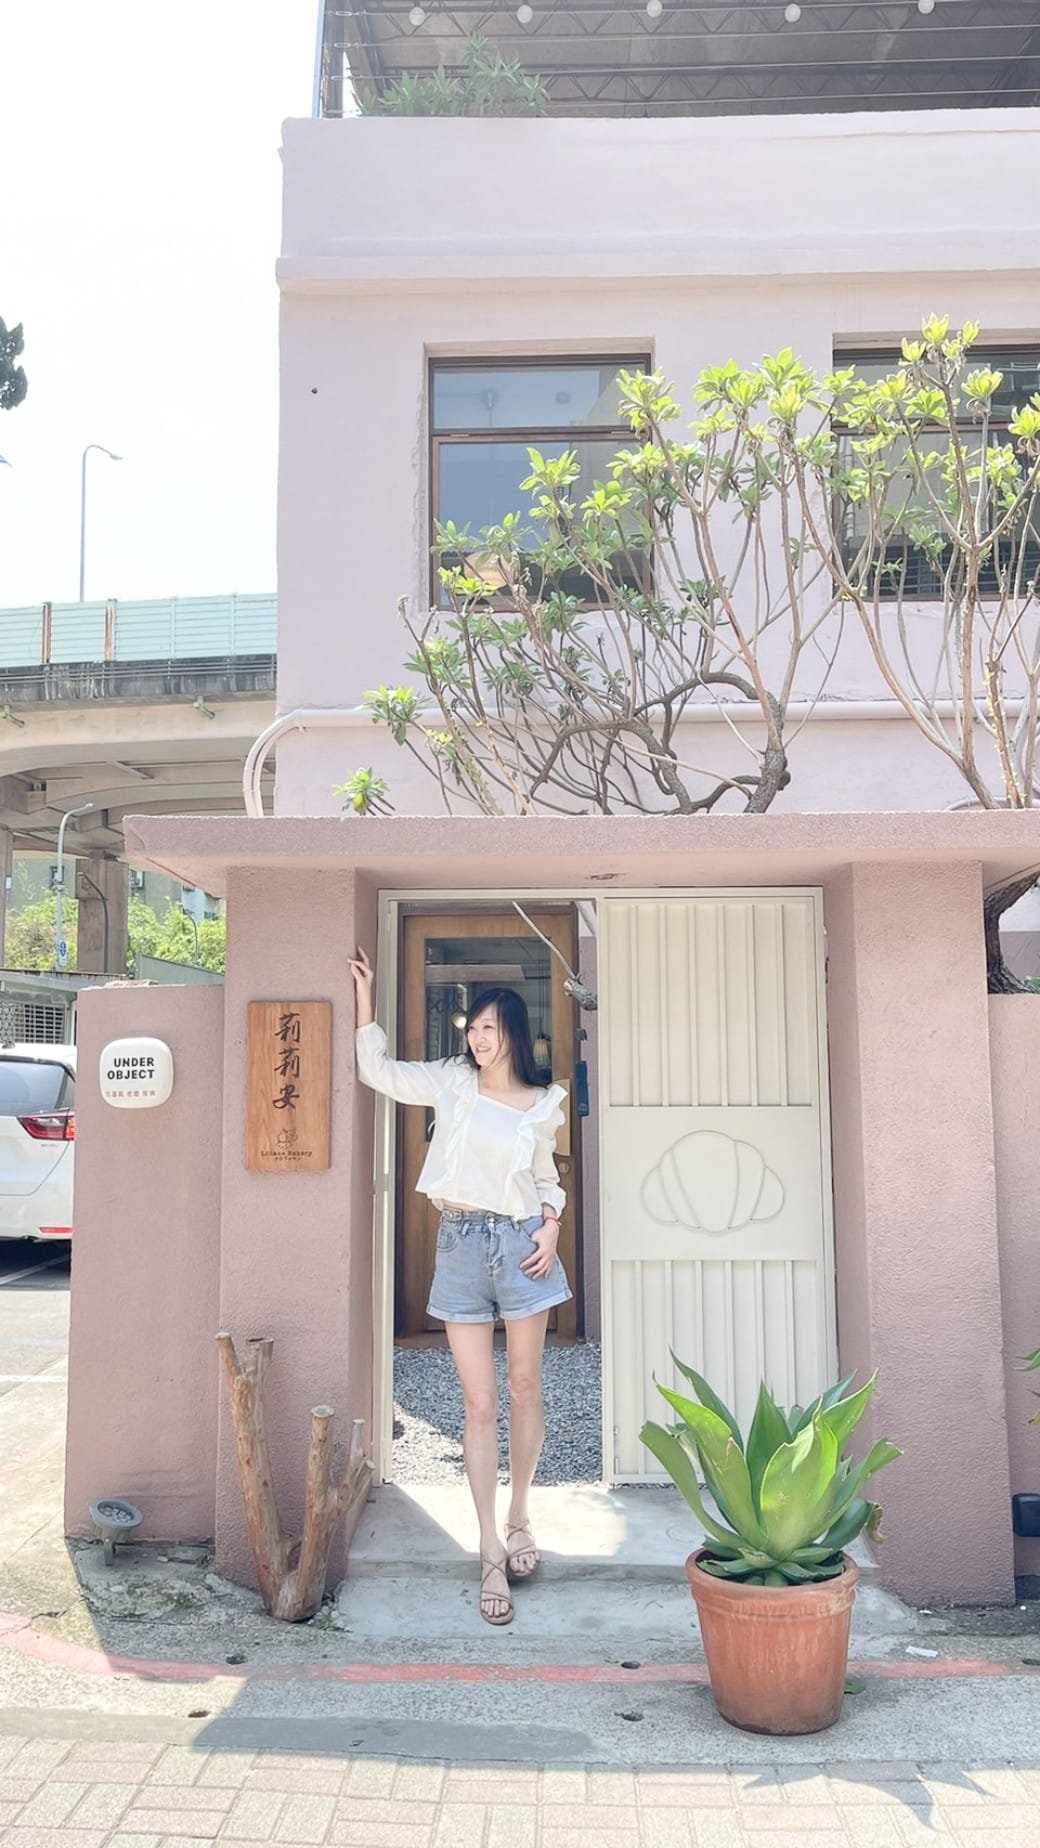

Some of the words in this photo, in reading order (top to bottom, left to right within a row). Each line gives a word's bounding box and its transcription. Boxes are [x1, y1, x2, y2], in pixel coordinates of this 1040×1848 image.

[113, 1057, 155, 1068] UNDER
[272, 1012, 301, 1110] 莉莉安
[107, 1069, 155, 1080] OBJECT
